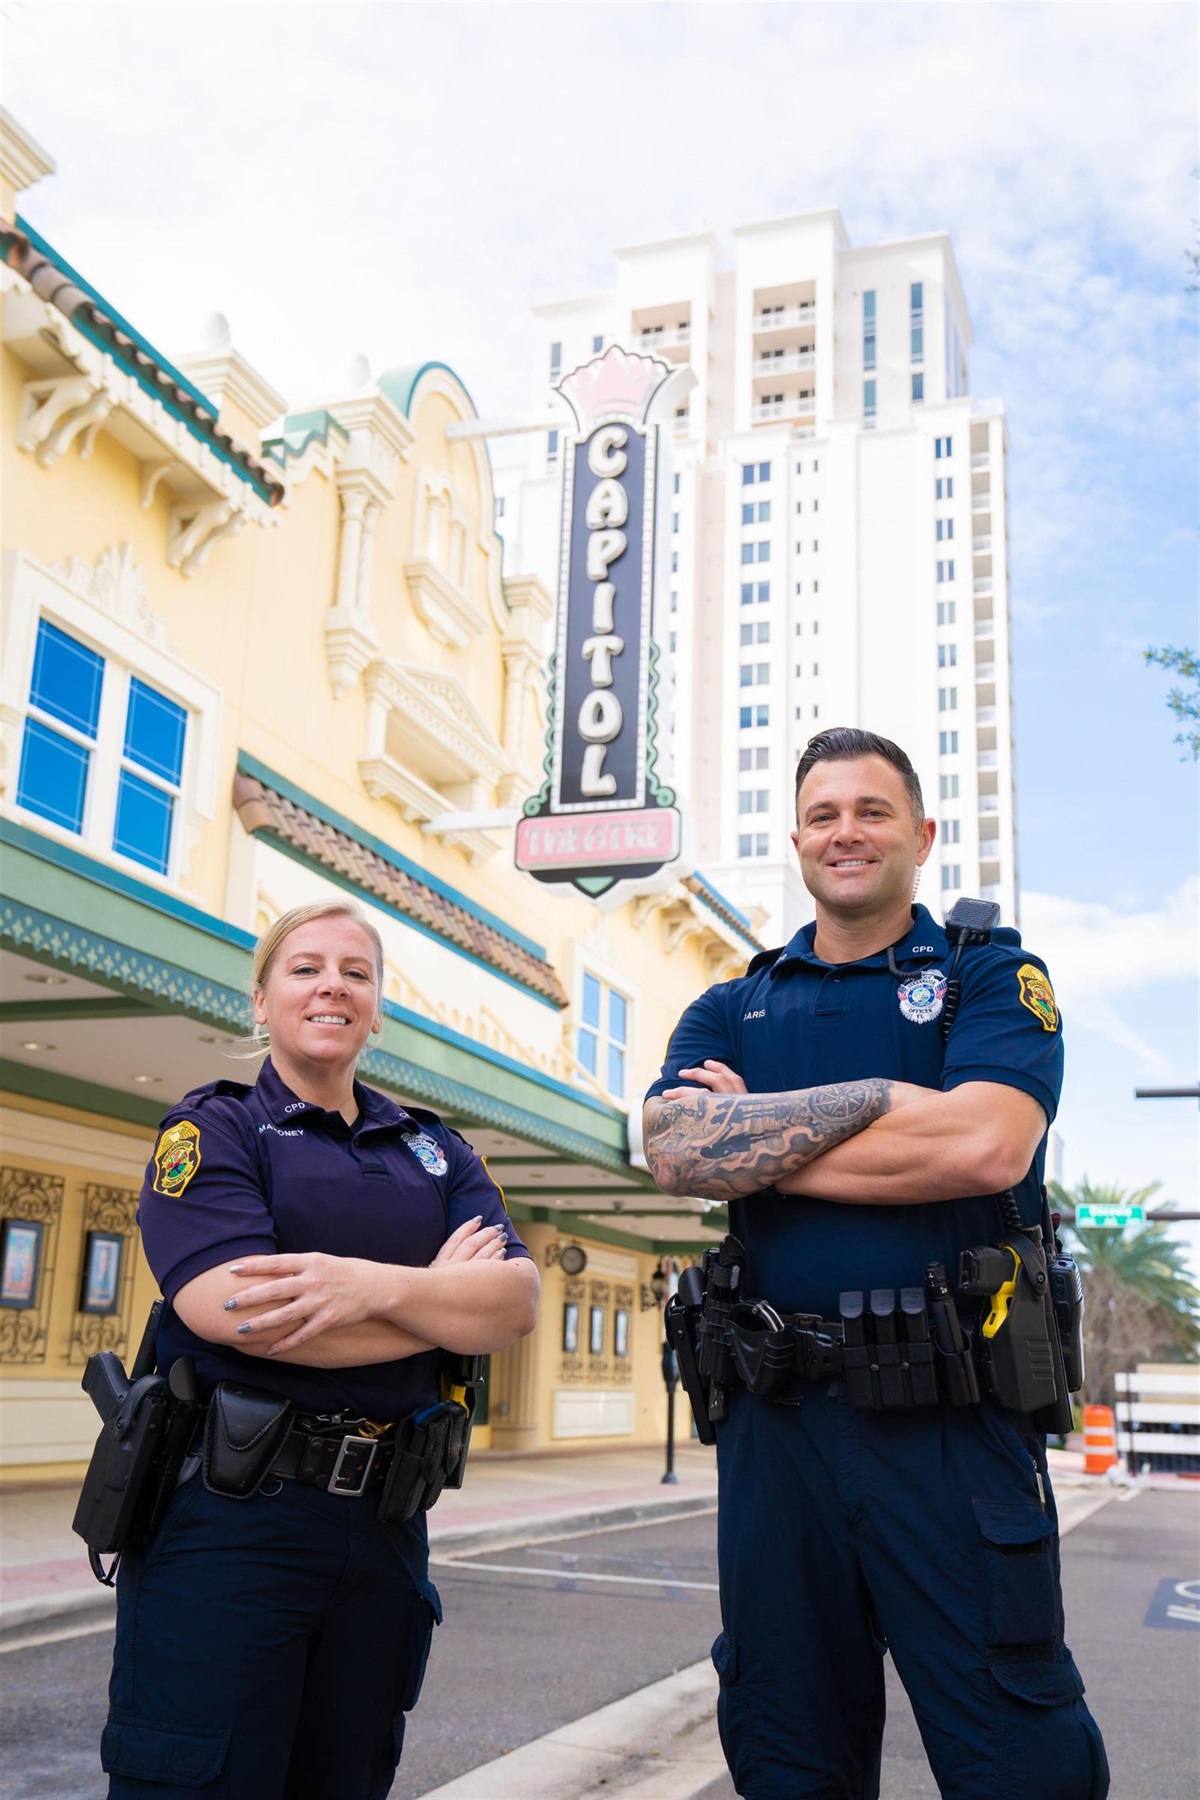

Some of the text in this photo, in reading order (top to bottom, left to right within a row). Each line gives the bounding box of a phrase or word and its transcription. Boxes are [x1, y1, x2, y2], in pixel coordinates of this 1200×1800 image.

[578, 426, 628, 797] CAPITOL
[525, 820, 664, 856] THEATRE
[912, 945, 934, 954] CPD
[284, 1102, 306, 1113] CPD
